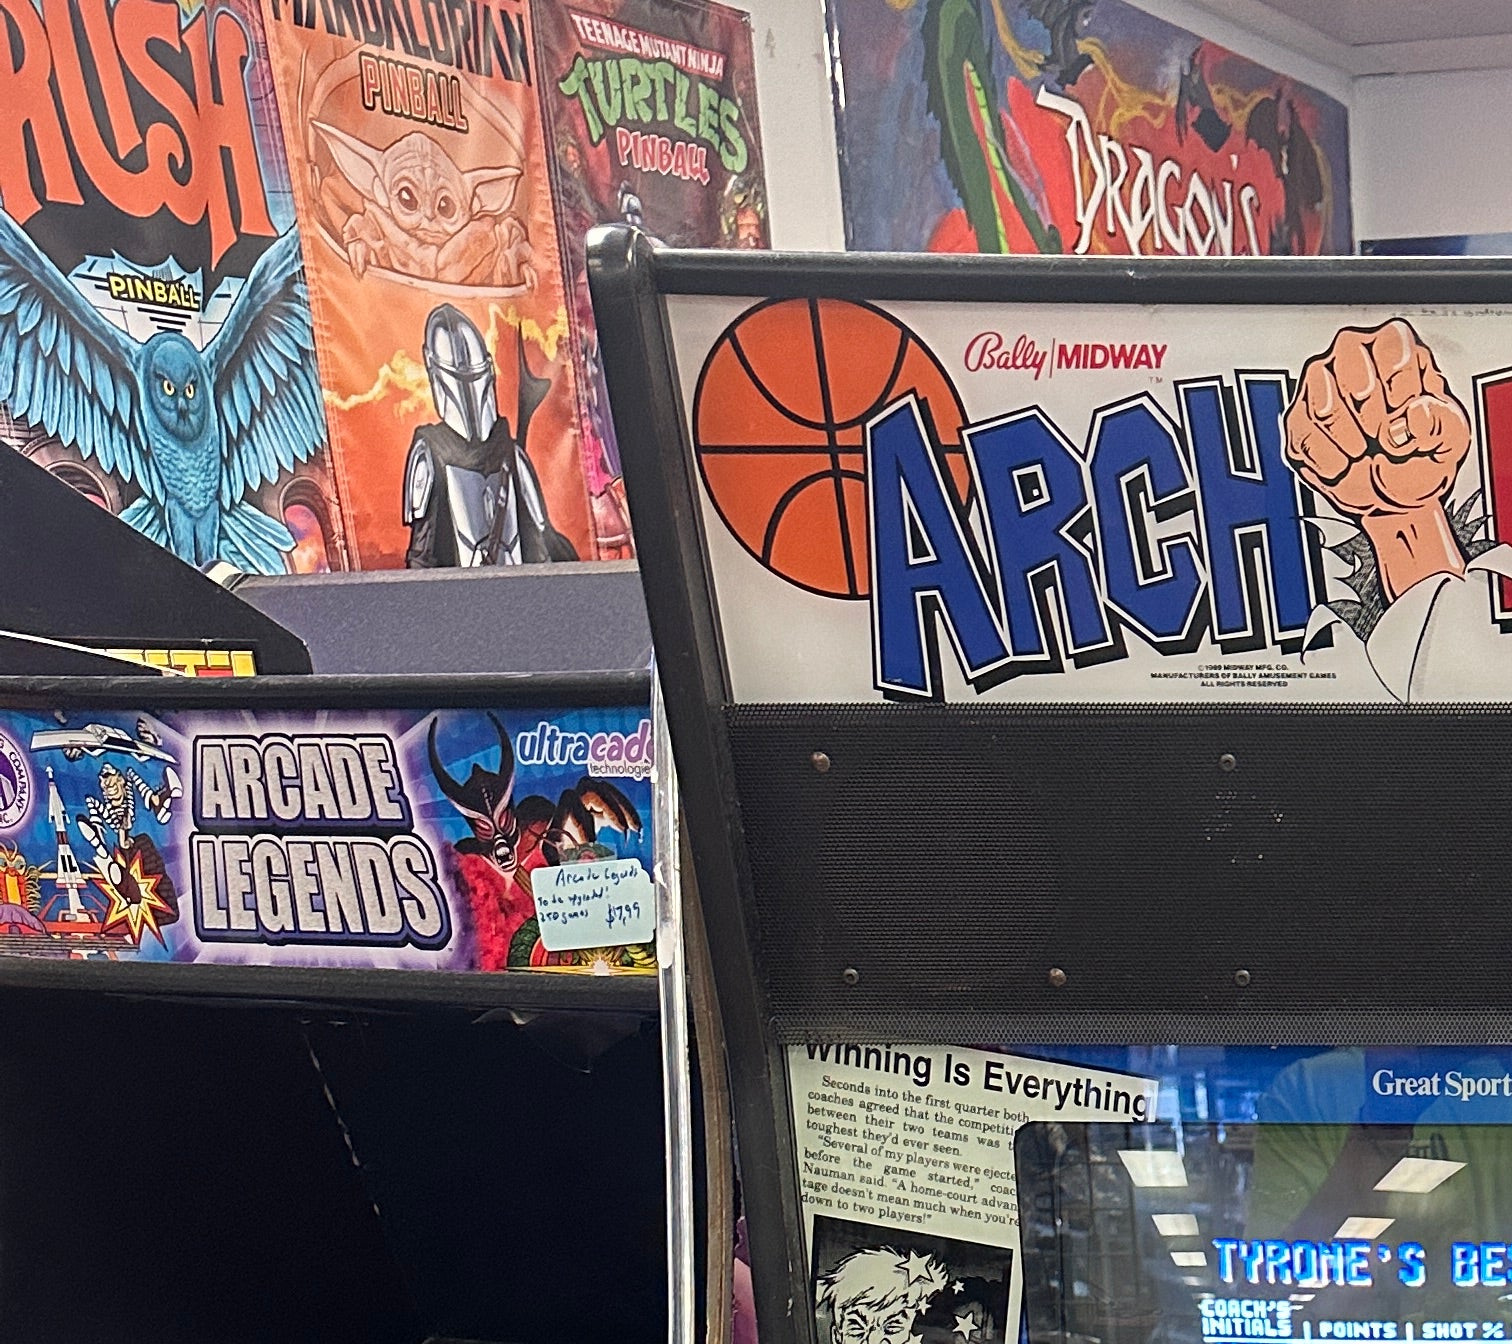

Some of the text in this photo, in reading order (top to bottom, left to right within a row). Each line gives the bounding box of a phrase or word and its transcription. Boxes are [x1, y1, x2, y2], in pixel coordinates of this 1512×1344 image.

[570, 13, 724, 77] TEENAGE MUTANT NINJA
[360, 53, 468, 132] PINBALL
[558, 56, 748, 173] TURTLES
[0, 0, 278, 271] RUSH
[616, 127, 710, 186] PINBALL
[108, 273, 201, 308] PINBALL
[964, 331, 1048, 381] Bally
[1056, 344, 1168, 370] MIDWAY
[866, 368, 1326, 699] ARCH
[519, 721, 652, 763] ultracad
[198, 740, 406, 822] ARCADE
[590, 762, 650, 778] technologie
[196, 839, 444, 939] LEGENDS
[822, 1075, 1030, 1124] Seconds into the first quarter both
[944, 1054, 971, 1087] Is
[983, 1061, 1151, 1123] Everything
[1372, 1069, 1441, 1097] Great
[1212, 1238, 1427, 1288] TYRONE'S
[1200, 1299, 1291, 1318] COACH'S
[1201, 1318, 1292, 1337] INITIALS
[1319, 1321, 1398, 1338] POINTS
[1422, 1321, 1477, 1338] SHOT
[1483, 1321, 1504, 1338] %
